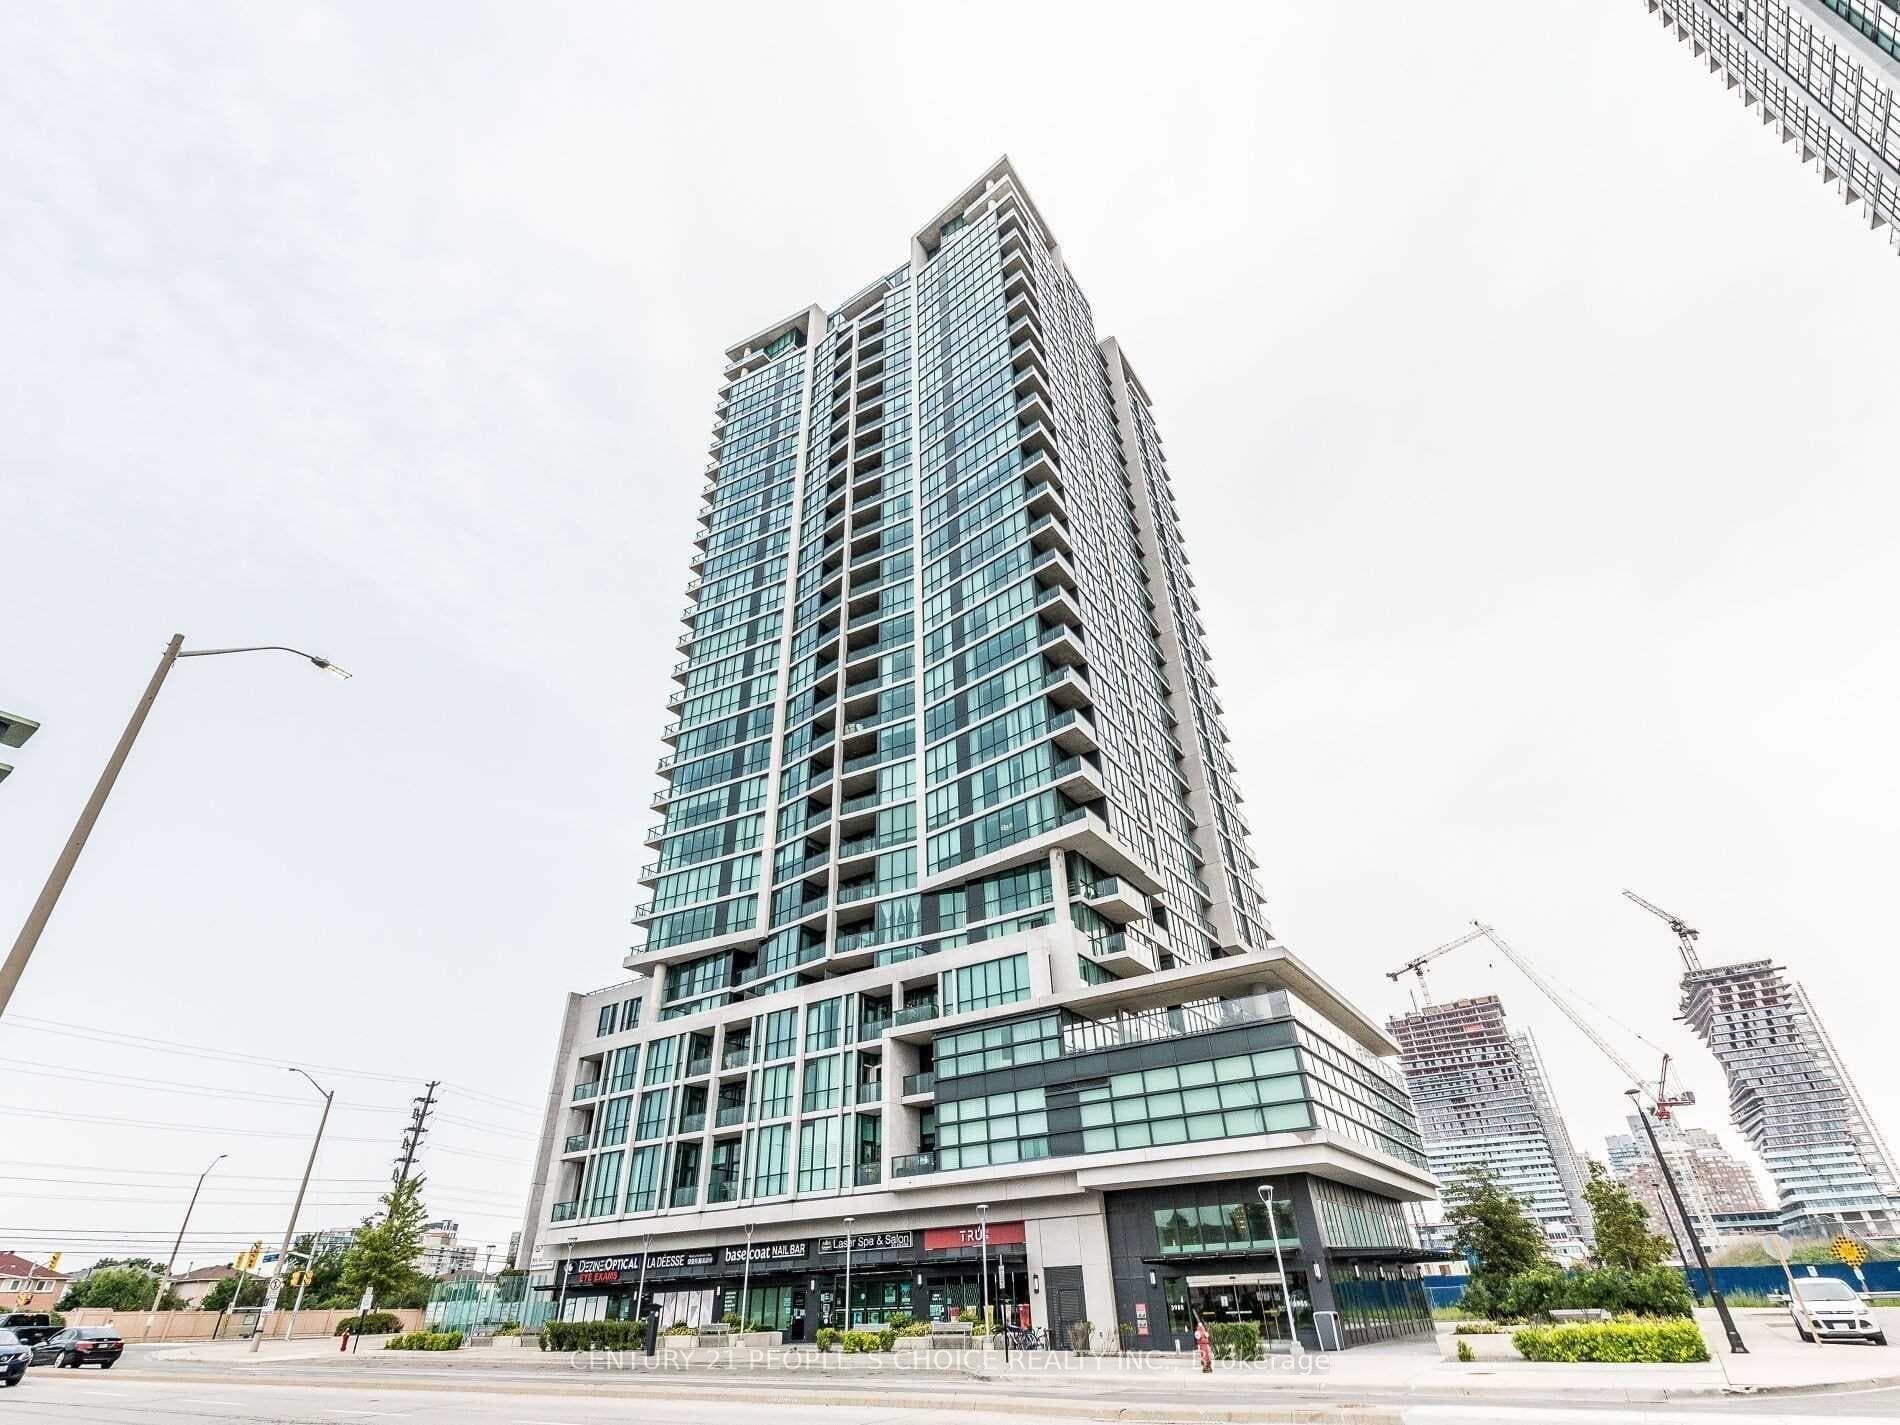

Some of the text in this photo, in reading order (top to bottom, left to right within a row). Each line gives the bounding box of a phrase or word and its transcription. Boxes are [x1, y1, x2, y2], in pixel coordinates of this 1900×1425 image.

[858, 1236, 875, 1249] Spa
[876, 1235, 883, 1245] &
[885, 1233, 909, 1245] Salon
[772, 1243, 806, 1256] NAIL BAR
[579, 1270, 618, 1283] EYE EXAMS
